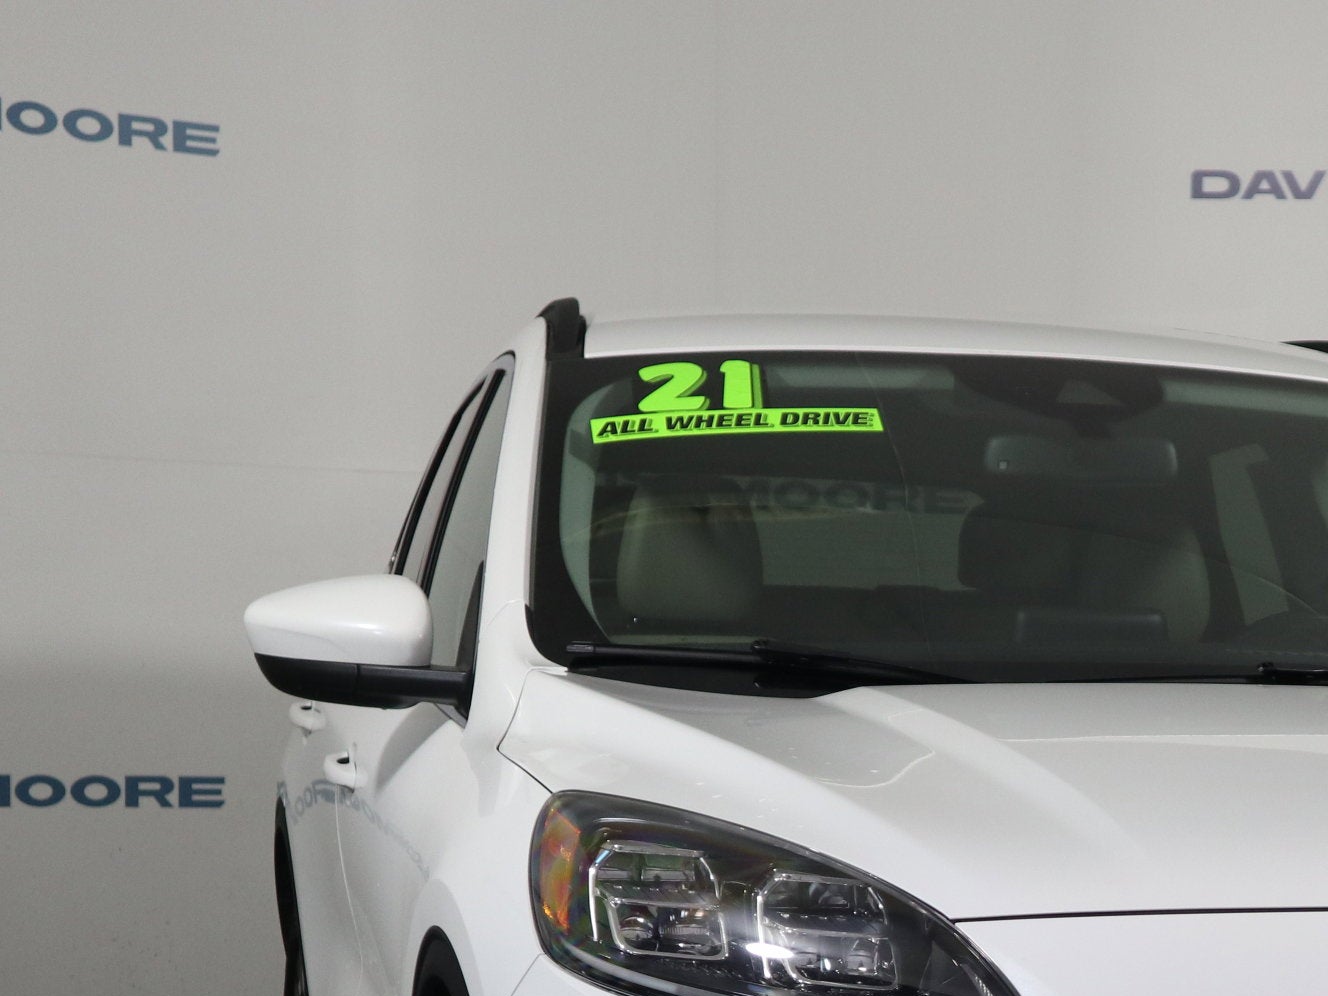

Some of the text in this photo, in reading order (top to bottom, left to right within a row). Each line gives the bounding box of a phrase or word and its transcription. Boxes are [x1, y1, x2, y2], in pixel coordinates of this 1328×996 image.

[0, 98, 220, 156] OORE
[637, 359, 762, 413] 21
[597, 410, 871, 437] ALL WHEEL DRIVE
[0, 774, 226, 808] OORE
